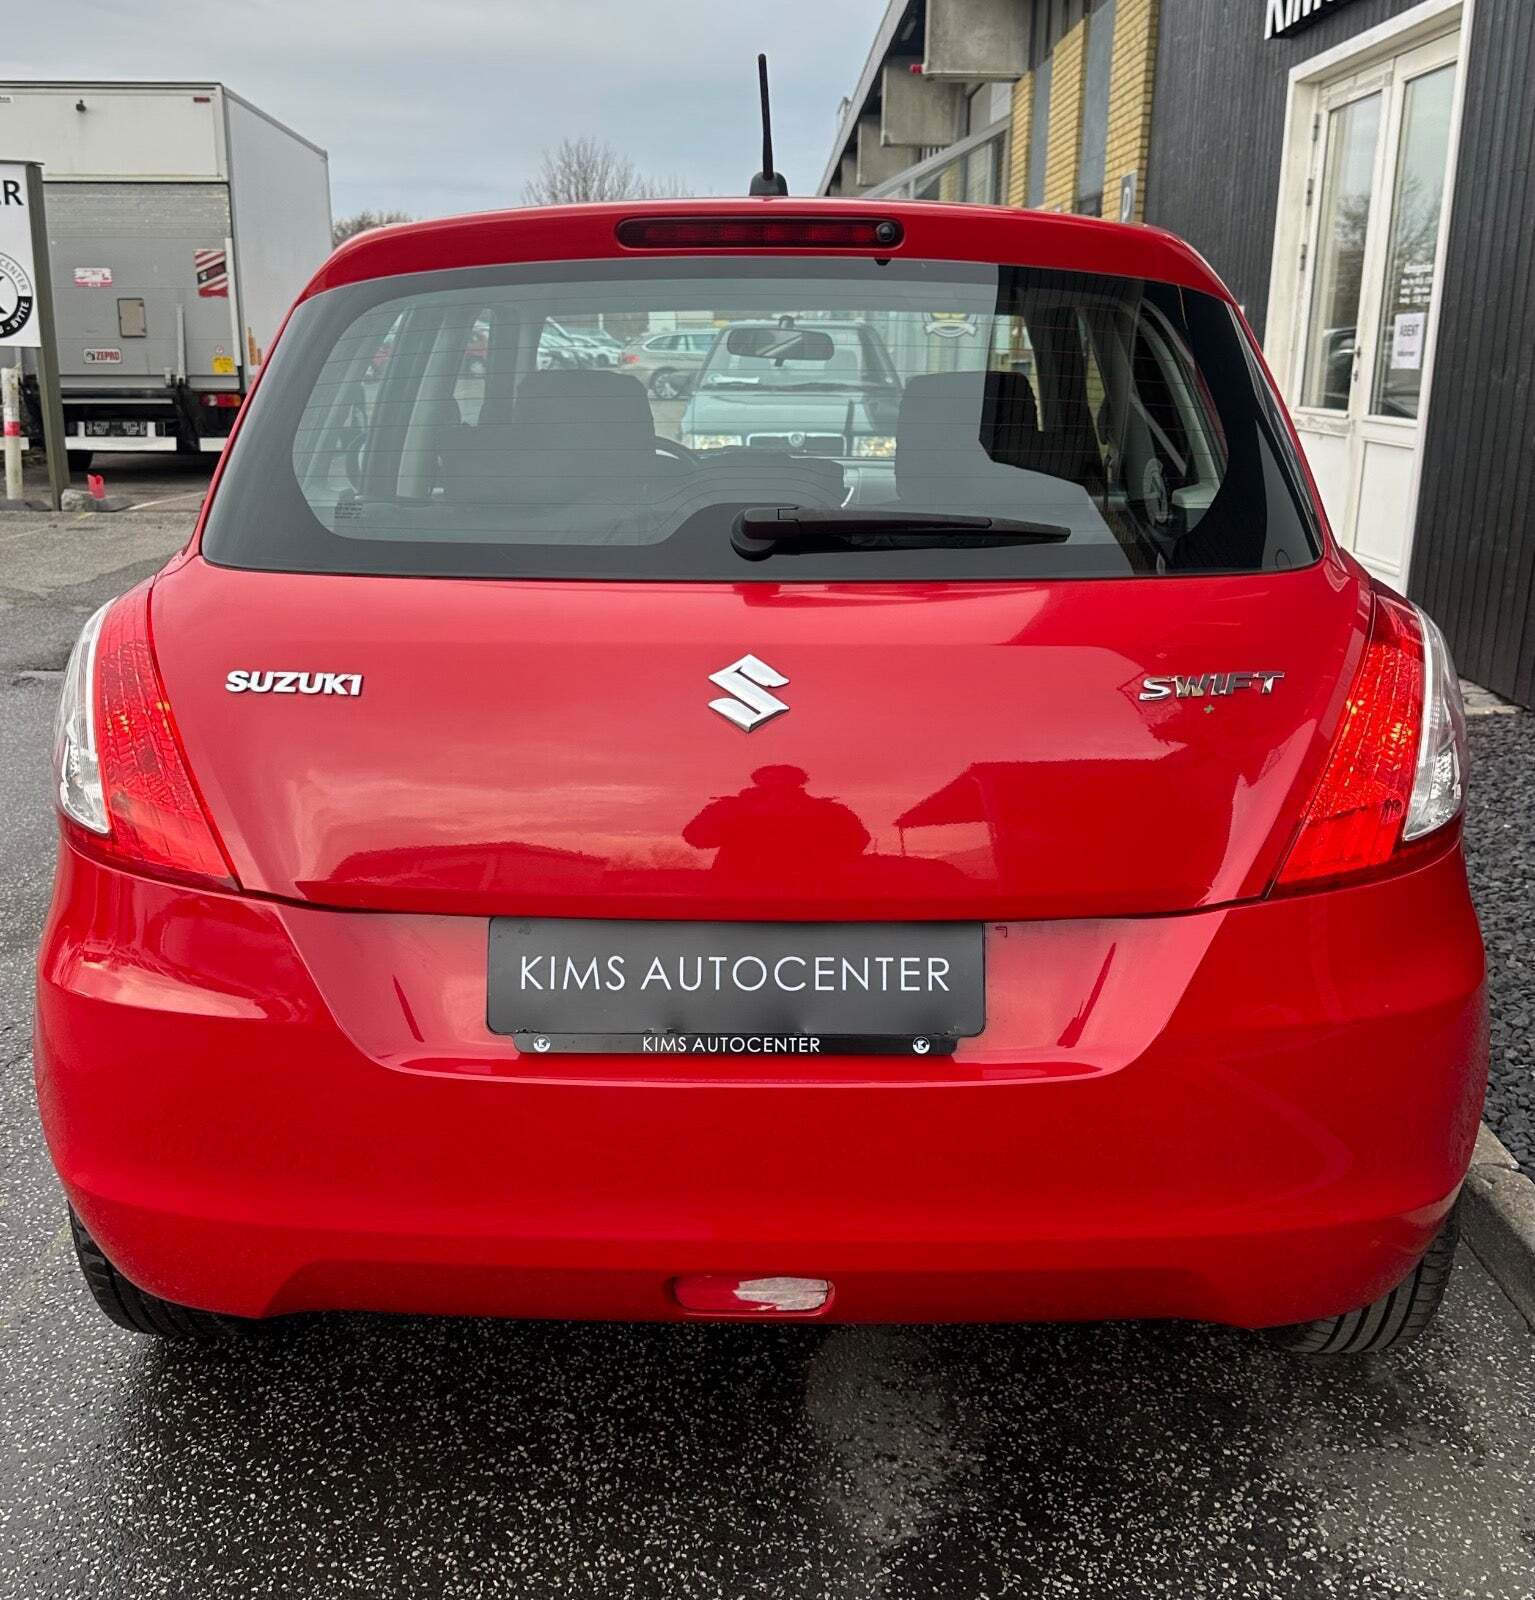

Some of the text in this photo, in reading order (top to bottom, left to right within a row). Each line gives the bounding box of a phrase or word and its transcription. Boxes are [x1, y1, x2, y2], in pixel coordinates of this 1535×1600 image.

[0, 180, 24, 206] R
[10, 301, 30, 328] BYTTE
[225, 670, 363, 696] SUZUKI
[1138, 670, 1285, 701] SWIFT
[520, 956, 951, 992] KIMS AUTOCENTER
[642, 1036, 821, 1053] KIMS AUTOCENTER
